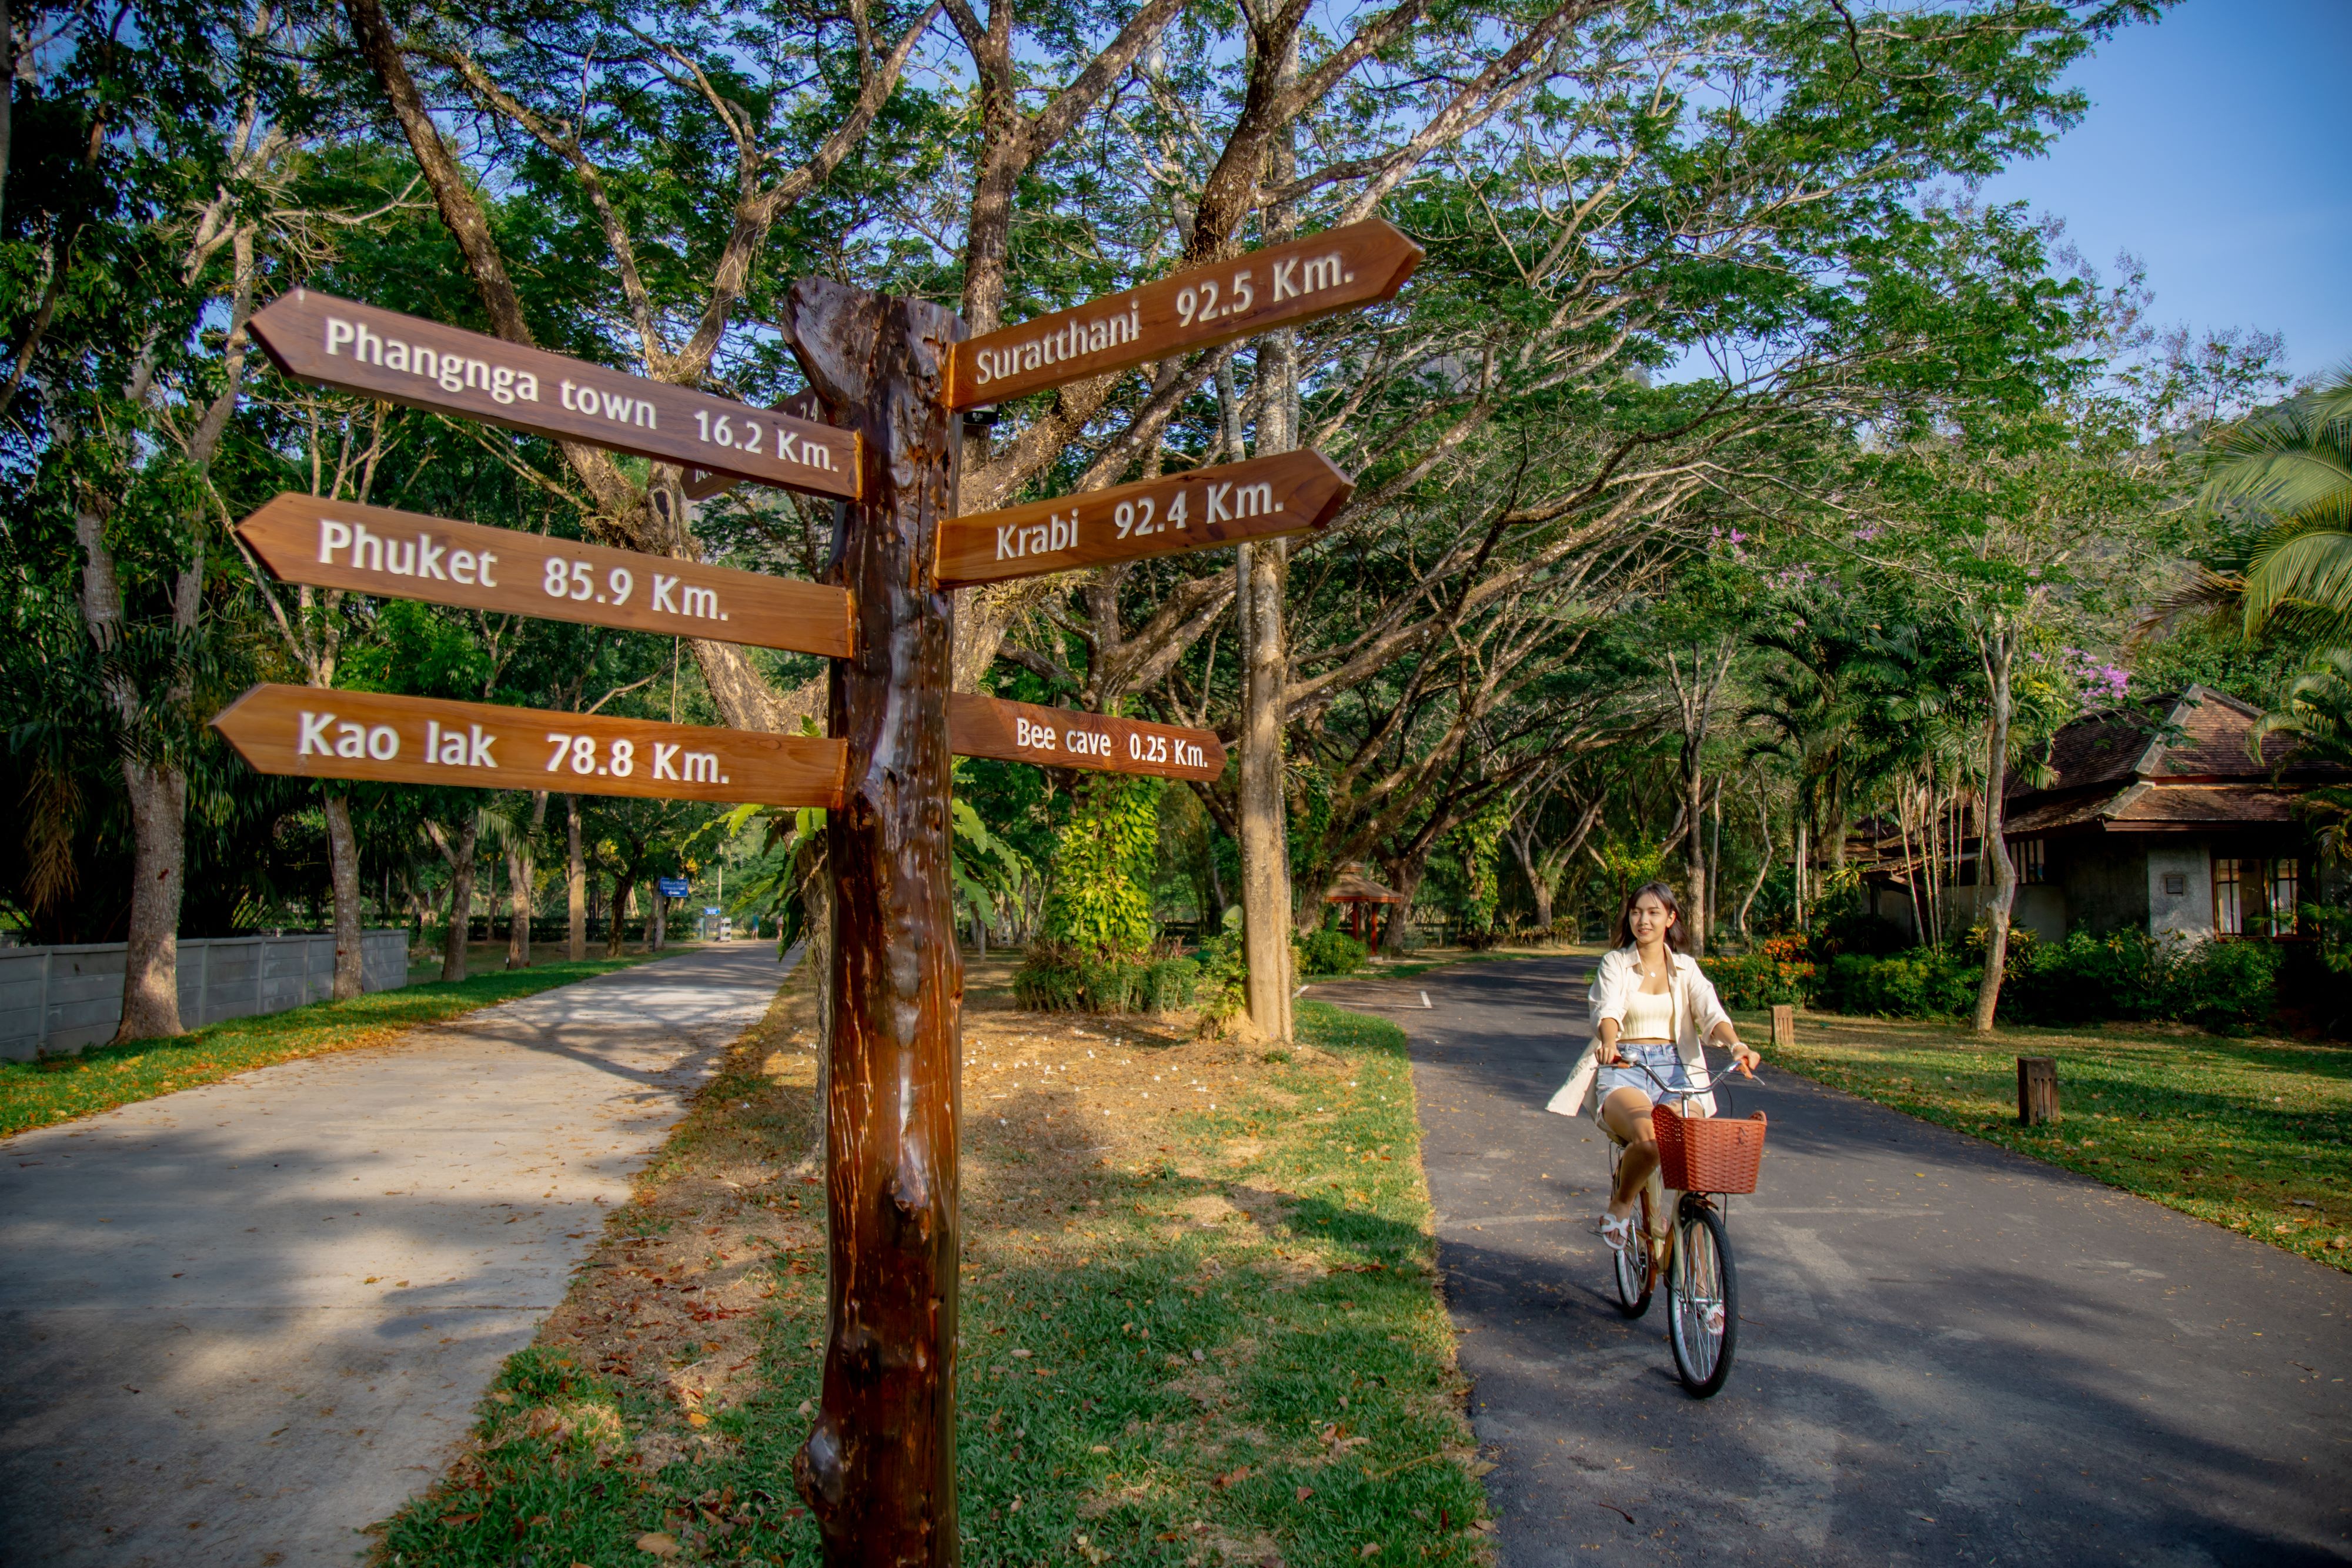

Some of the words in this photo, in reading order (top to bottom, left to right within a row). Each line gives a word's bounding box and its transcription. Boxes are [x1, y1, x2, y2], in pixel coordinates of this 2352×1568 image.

[975, 300, 1141, 386] Suratthani
[1177, 270, 1254, 329] 92.5
[1272, 250, 1355, 302] Km.
[325, 317, 539, 404] Phangnga
[560, 378, 657, 430] town
[693, 409, 763, 455] 16.2
[776, 429, 840, 473] Km.
[996, 508, 1080, 562] Krabi
[1114, 489, 1188, 540] 92.4
[1206, 480, 1285, 525] Km.
[319, 519, 499, 589] Phuket
[543, 556, 634, 606] 85.9
[652, 574, 730, 622] Km.
[298, 711, 400, 761] Kao
[425, 721, 498, 768] lak
[546, 733, 634, 777] 78.8
[653, 743, 730, 784] Km.
[1016, 717, 1056, 751] Bee
[1065, 729, 1112, 757] cave
[1129, 733, 1168, 763] 0.25
[1174, 738, 1209, 768] Km.
